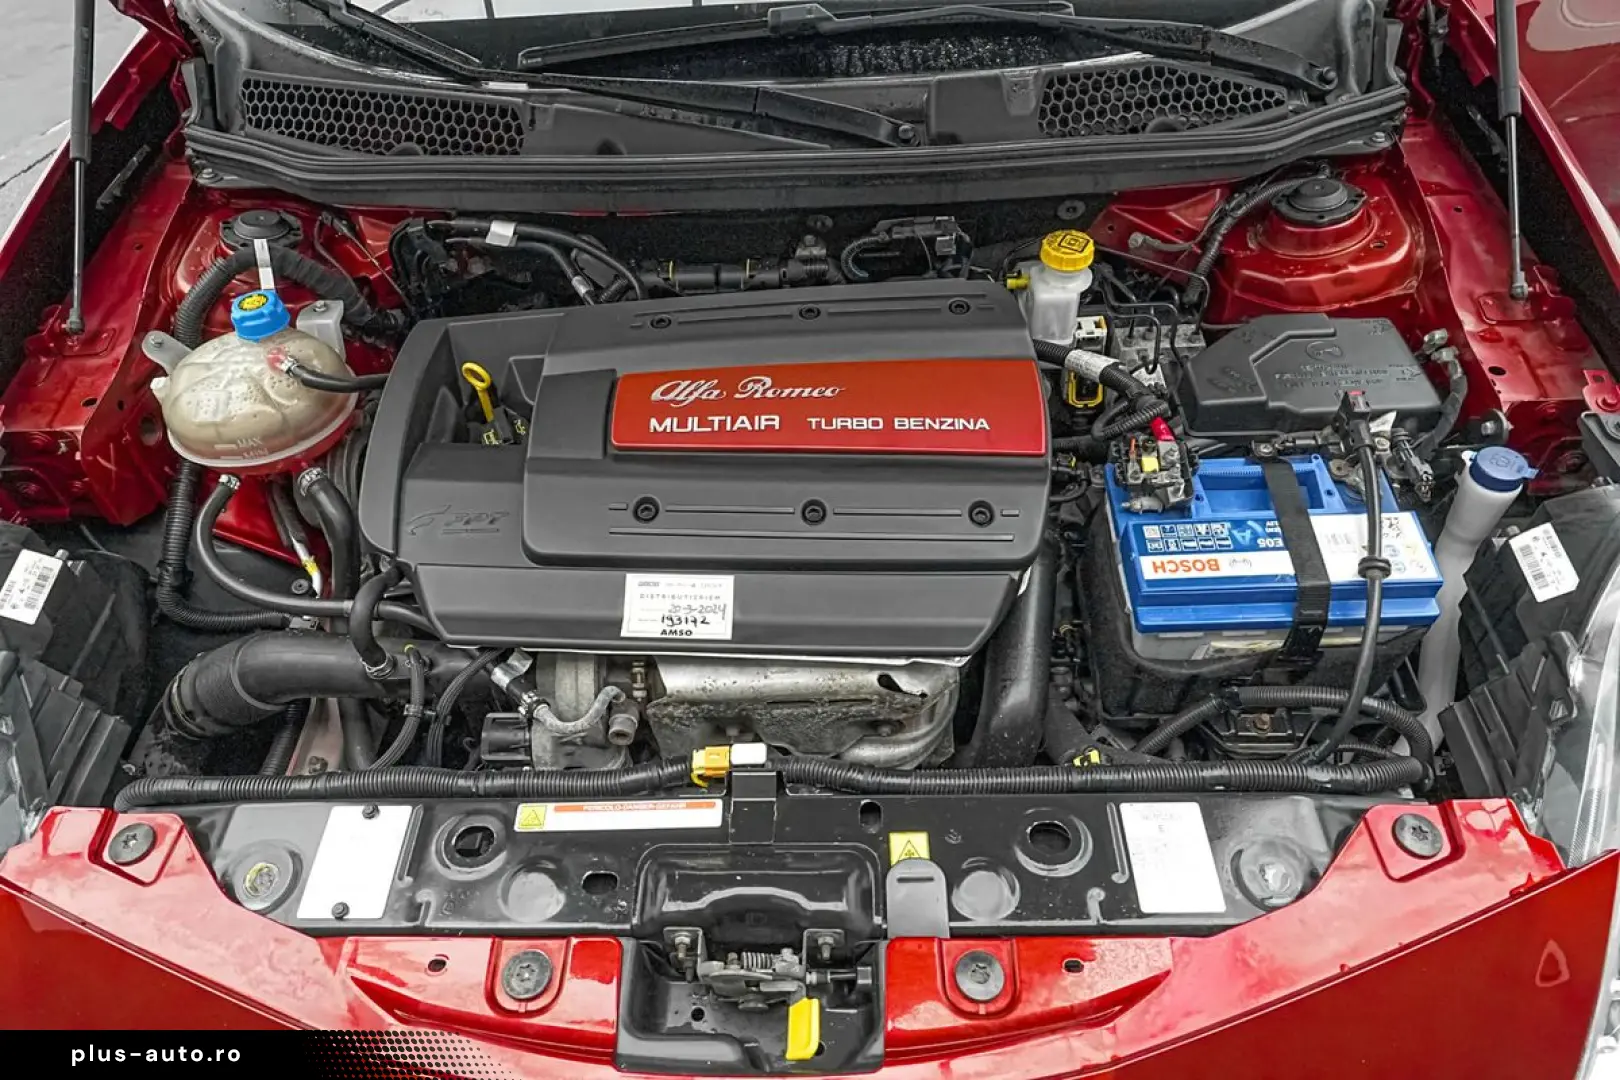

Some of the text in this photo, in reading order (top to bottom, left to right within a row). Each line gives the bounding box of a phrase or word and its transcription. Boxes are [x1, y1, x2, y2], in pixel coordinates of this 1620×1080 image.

[650, 375, 846, 407] Alfa Romeo
[648, 415, 780, 433] MULTIAIR
[806, 417, 991, 431] TURBO BENZINA
[237, 436, 264, 448] MAX
[1152, 558, 1220, 574] BOSCH
